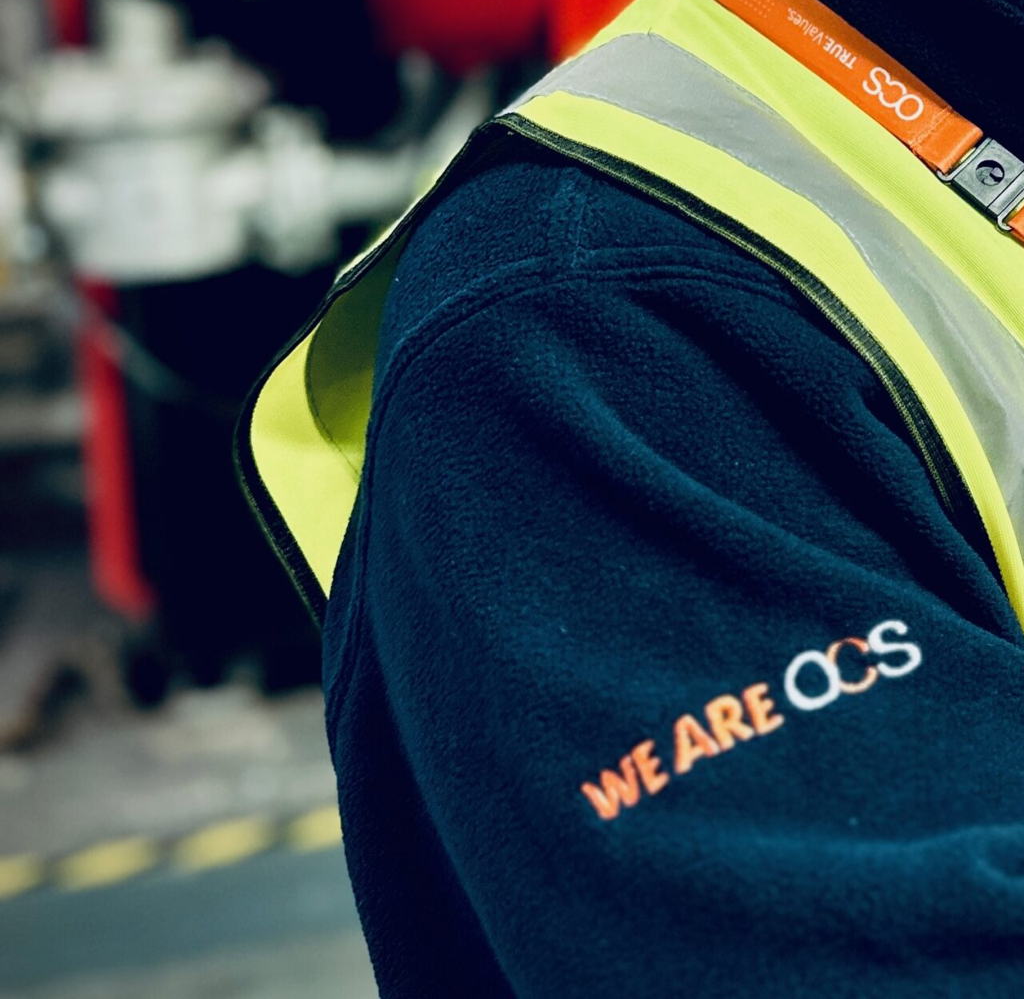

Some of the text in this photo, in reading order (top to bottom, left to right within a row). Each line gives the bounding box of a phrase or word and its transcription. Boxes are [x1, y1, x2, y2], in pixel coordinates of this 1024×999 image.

[862, 66, 924, 121] OCS
[580, 620, 922, 820] WE ARE OCS
